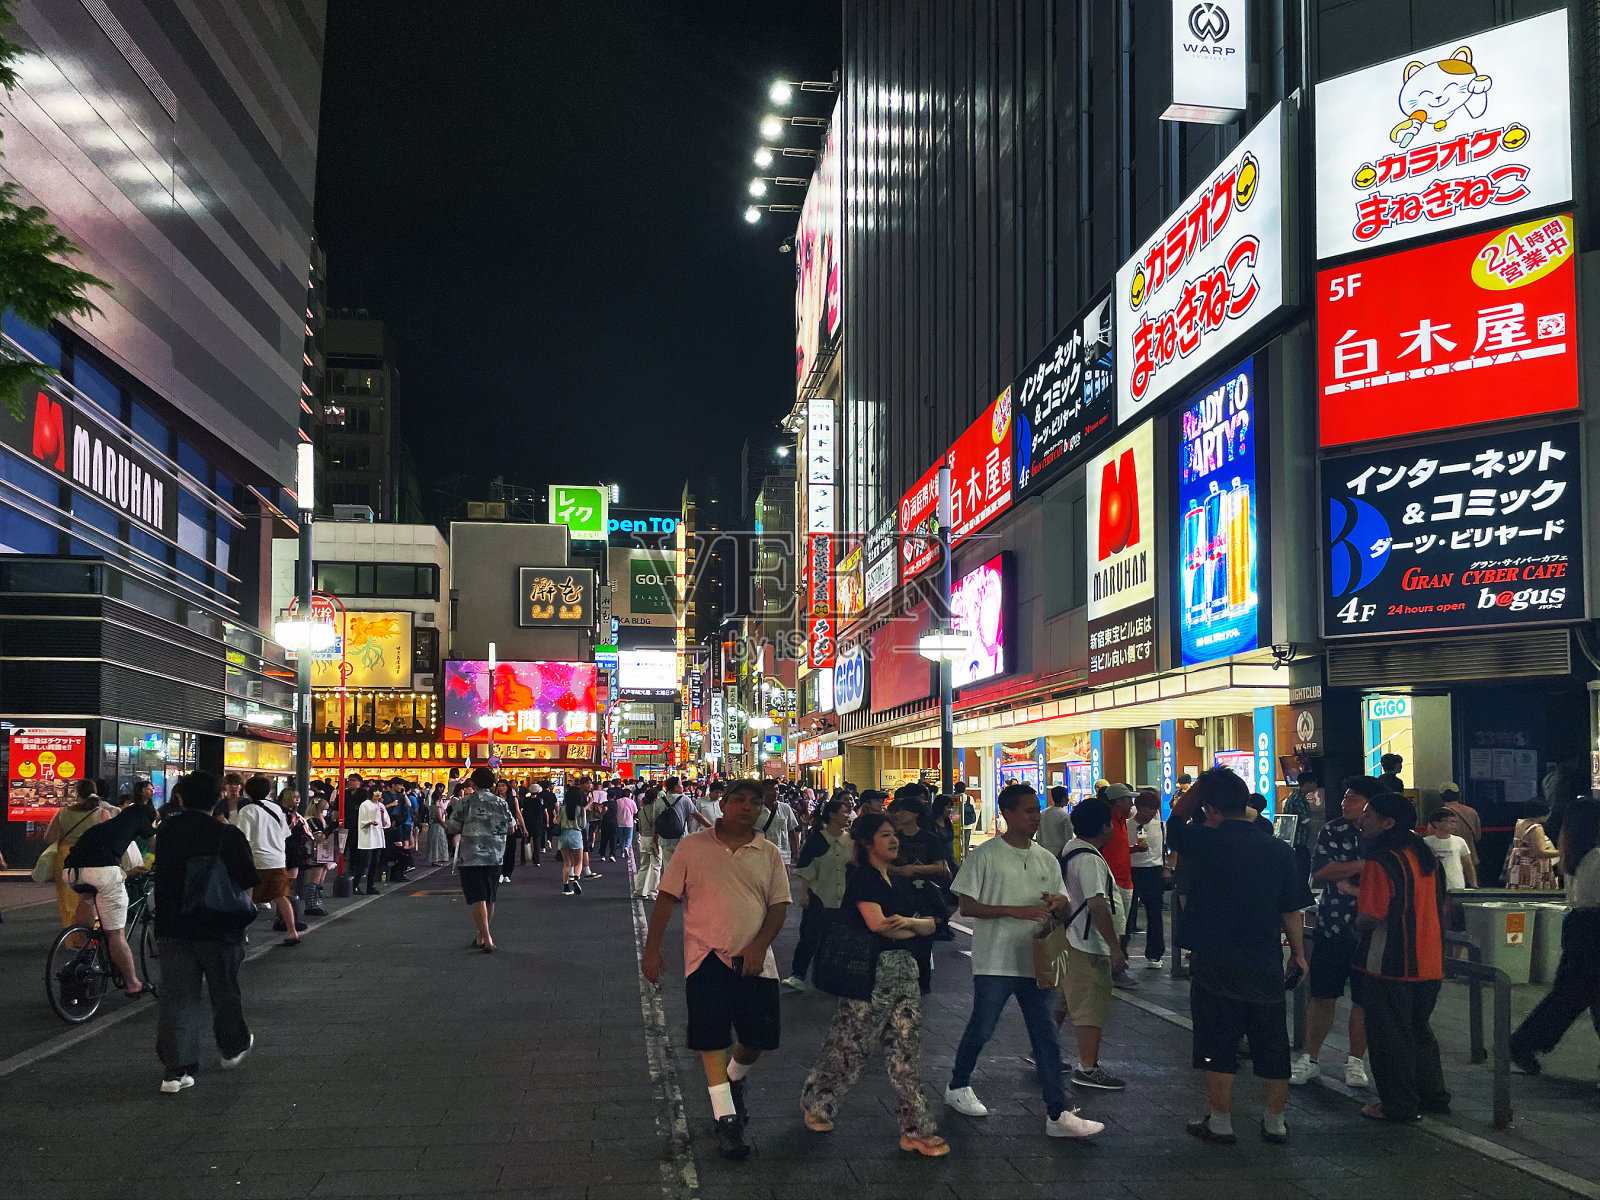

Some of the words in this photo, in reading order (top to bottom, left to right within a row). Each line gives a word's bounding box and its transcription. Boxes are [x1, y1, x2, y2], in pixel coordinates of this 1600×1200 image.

[1183, 44, 1236, 56] WARP
[1377, 129, 1502, 185] カラオケ
[1354, 165, 1530, 241] まねきねこ
[1145, 169, 1238, 300] カラオケ
[1479, 218, 1564, 270] 24時間
[1499, 236, 1569, 284] 営業中
[1329, 273, 1362, 301] 5F
[1132, 239, 1258, 398] まねきねこ
[1334, 302, 1532, 379] 白木屋
[1019, 328, 1082, 407] インターネット
[1031, 397, 1082, 454] ダーツ・ビリヤード
[1183, 384, 1225, 441] READY
[1226, 373, 1249, 415] TO
[1183, 409, 1249, 485] PARTY?
[1346, 440, 1567, 496] インターネット
[73, 425, 163, 530] MARUHAN
[950, 447, 1001, 529] 白木屋
[1019, 465, 1030, 489] 4F
[649, 517, 681, 533] TO
[1370, 518, 1566, 559] ダーツ・ビリヤード
[635, 574, 677, 586] GOLF
[813, 534, 830, 600] 横浜家系
[1093, 550, 1147, 602] MARUHAN
[1402, 566, 1454, 591] GRAN
[1461, 567, 1519, 586] CYBER
[1522, 563, 1568, 581] CAFE
[1090, 615, 1152, 650] 新宿東宝ビル店は
[1336, 597, 1377, 624] 4F
[1387, 604, 1404, 616] 24
[1404, 603, 1434, 614] hours
[1437, 602, 1466, 613] open
[813, 619, 830, 666] ラーメン
[1090, 640, 1152, 673] 当ビル向い側です
[1295, 742, 1317, 751] WARP
